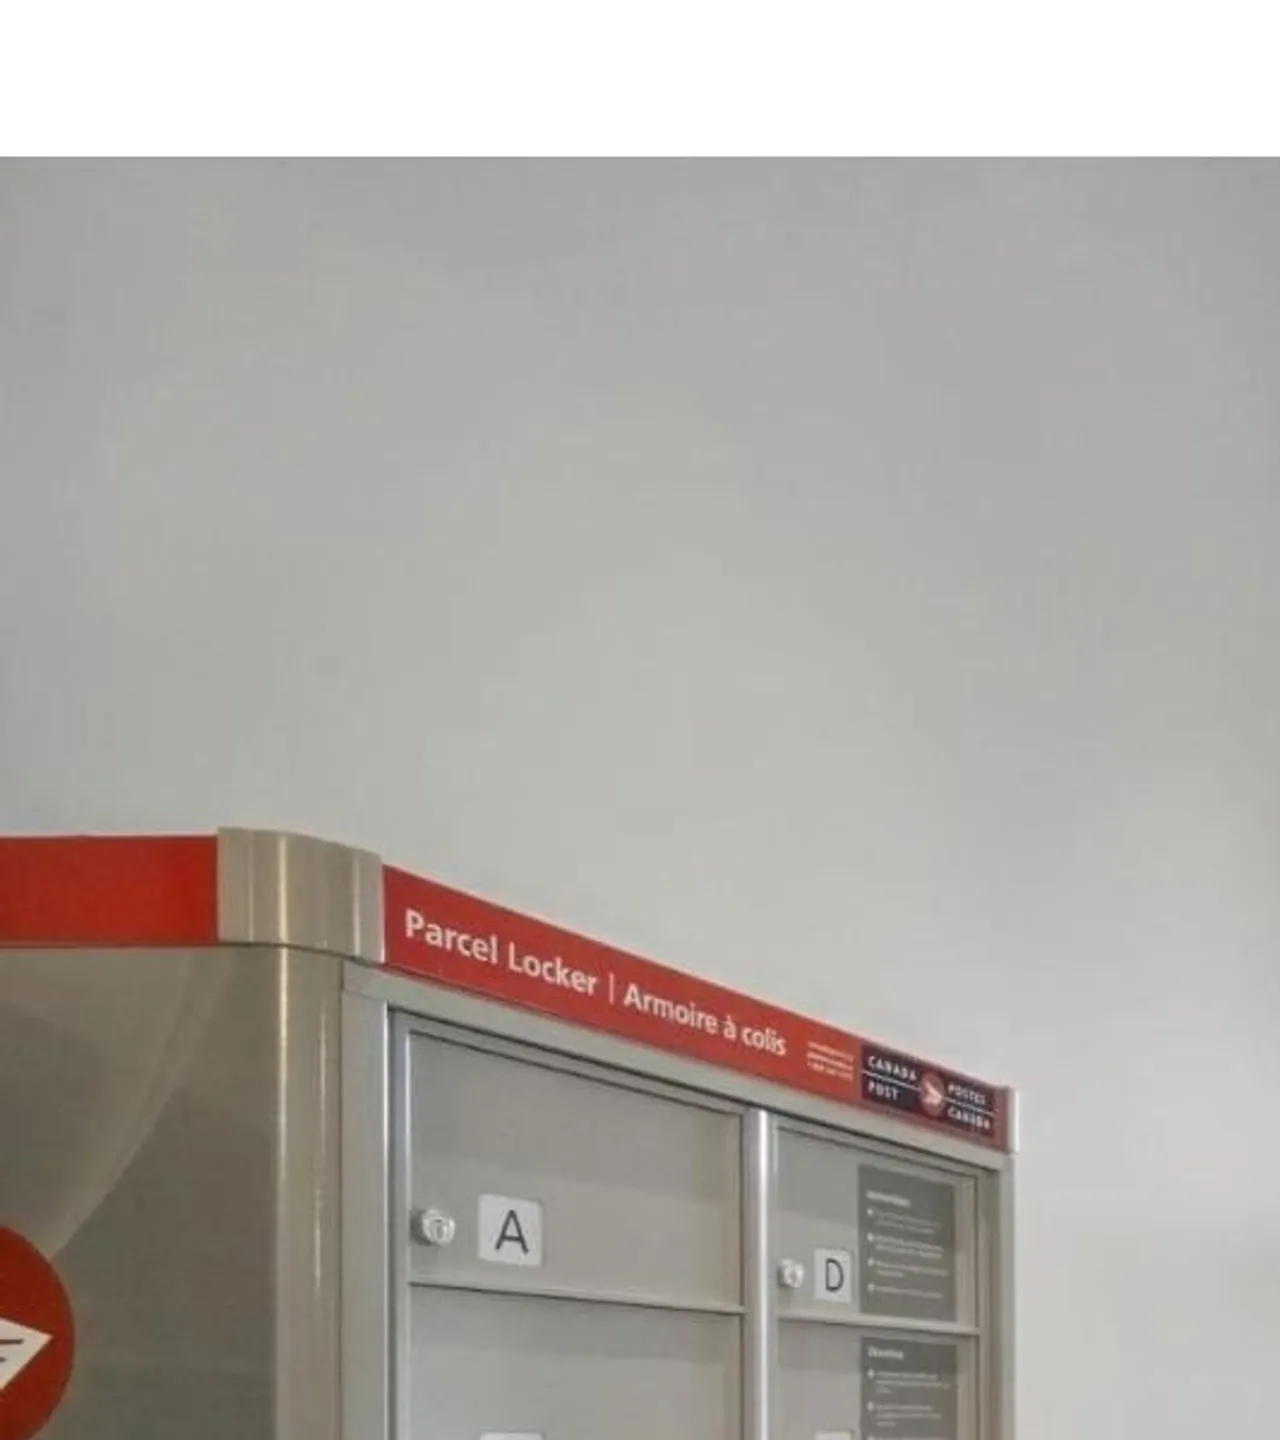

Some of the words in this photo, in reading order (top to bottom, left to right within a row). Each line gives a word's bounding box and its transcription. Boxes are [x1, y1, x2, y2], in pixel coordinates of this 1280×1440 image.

[405, 908, 499, 965] Parcel
[508, 941, 599, 998] Locker
[623, 983, 719, 1037] Armoire
[722, 1015, 737, 1042] à
[742, 1024, 788, 1058] colis
[867, 1055, 918, 1081] CANADA
[867, 1080, 899, 1100] POST
[495, 1208, 529, 1255] A
[825, 1257, 844, 1292] D
